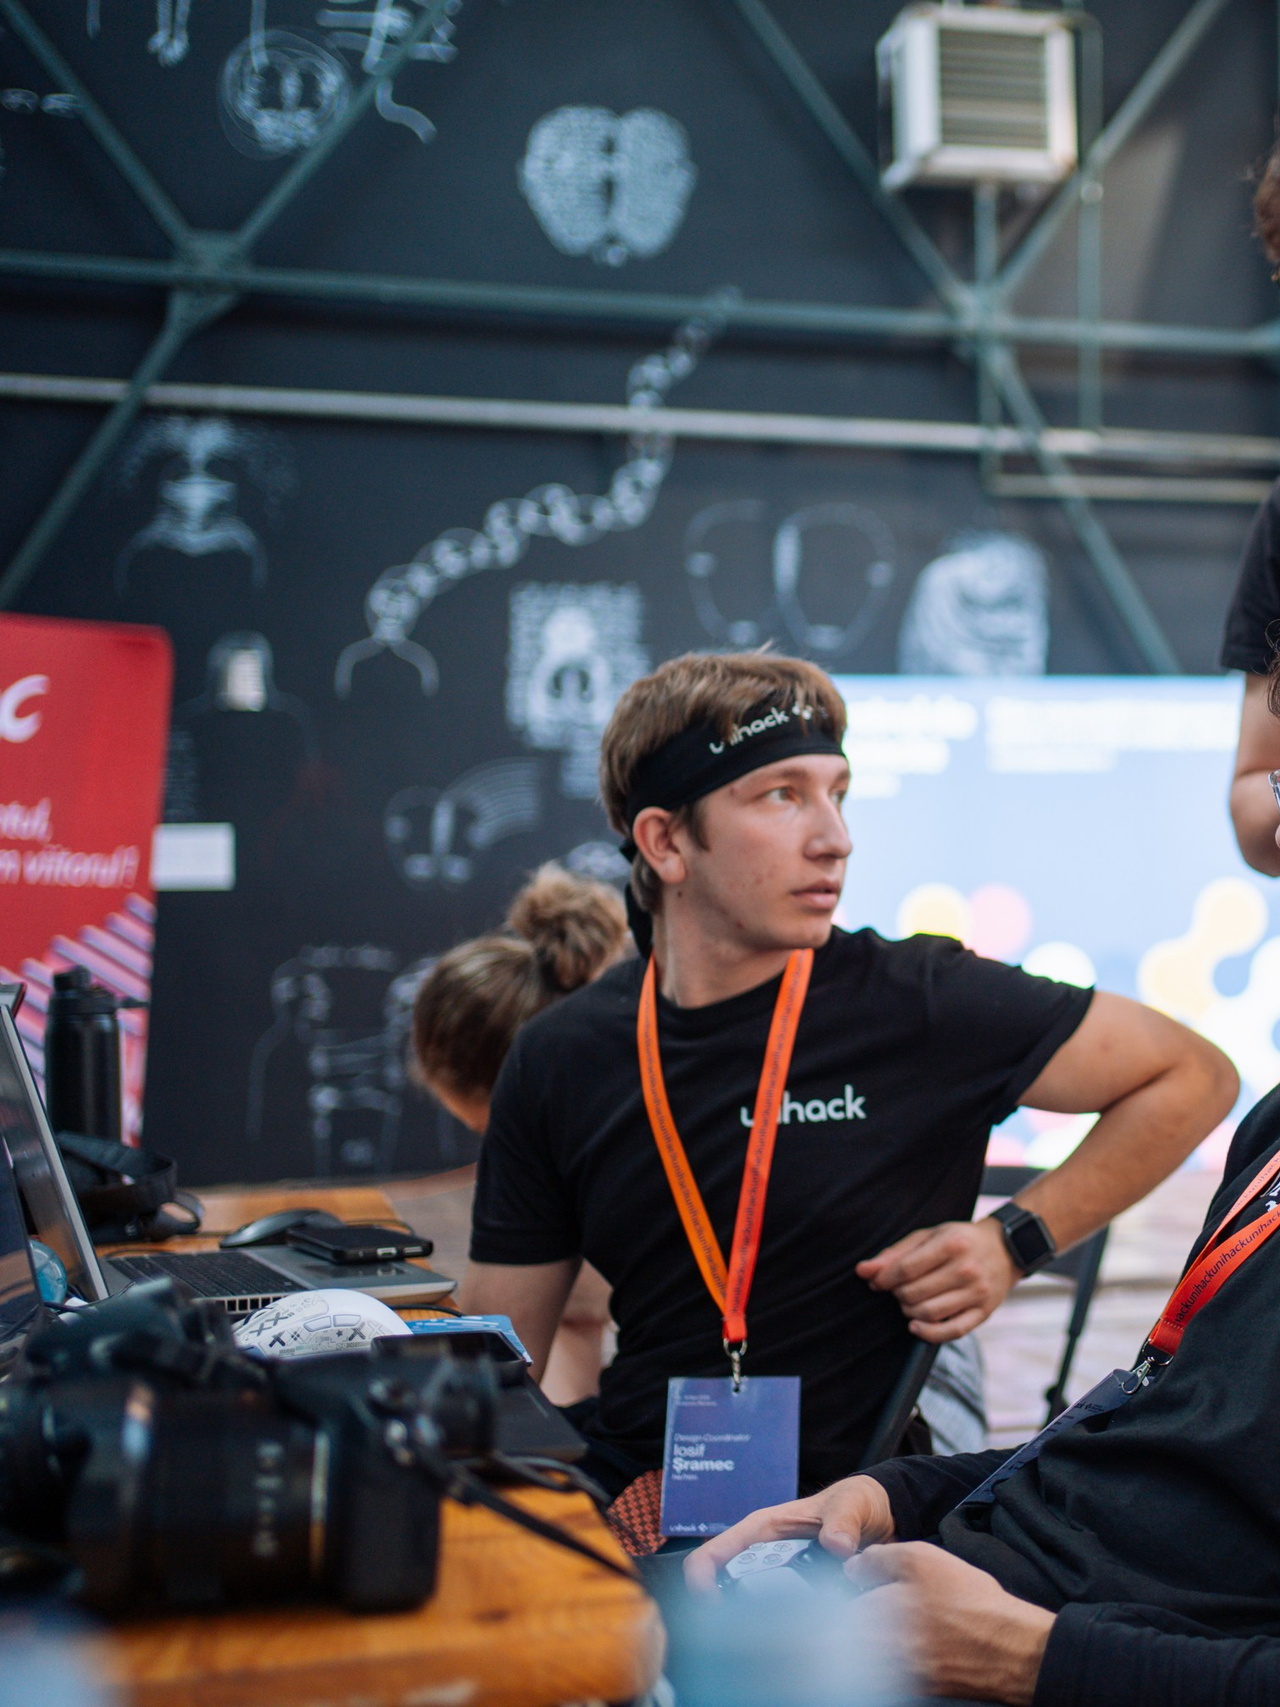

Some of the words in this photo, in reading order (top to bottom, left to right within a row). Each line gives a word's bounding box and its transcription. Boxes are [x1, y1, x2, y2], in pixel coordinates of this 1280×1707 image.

[709, 706, 790, 754] uihack
[740, 1084, 867, 1128] uhack
[674, 1443, 705, 1457] Iosif
